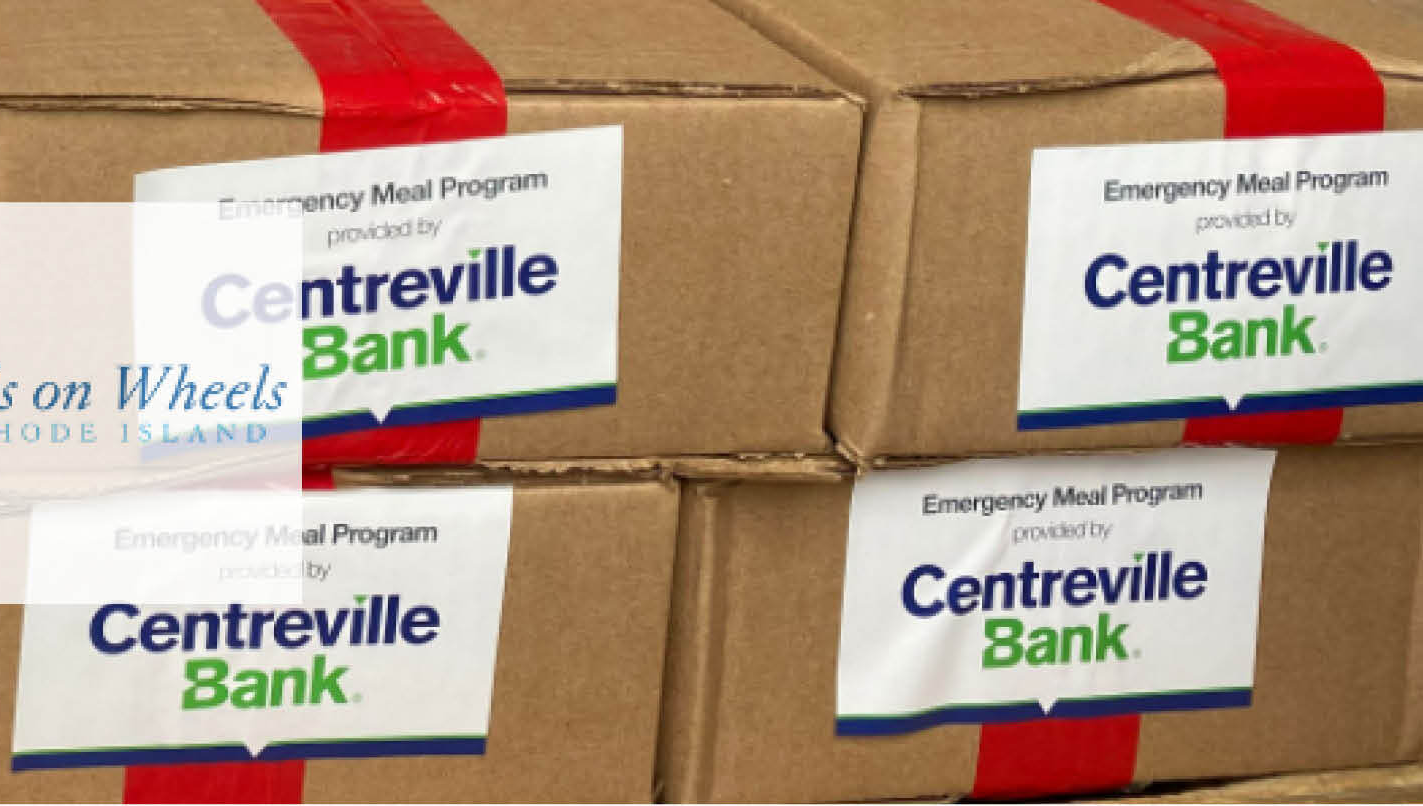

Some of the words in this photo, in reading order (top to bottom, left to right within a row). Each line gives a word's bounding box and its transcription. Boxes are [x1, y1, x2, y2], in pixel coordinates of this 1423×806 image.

[219, 188, 364, 220] Emergency
[371, 179, 432, 205] Meal
[442, 171, 548, 200] Program
[1104, 177, 1232, 204] Emergency
[1236, 171, 1290, 194] Meal
[1296, 169, 1389, 192] Program
[328, 221, 411, 248] provided
[416, 215, 442, 239] by
[1195, 210, 1271, 234] provided
[1274, 210, 1296, 229] by
[202, 244, 559, 329] Centreville
[1084, 239, 1394, 309] Centreville
[302, 313, 471, 381] Bank
[1166, 304, 1317, 364] Bank
[922, 490, 1047, 516] Emergency
[1052, 485, 1108, 508] Meal
[1112, 481, 1203, 506] Program
[113, 527, 259, 553] Emergency
[265, 524, 325, 546] Meal
[333, 523, 438, 548] Program
[1012, 521, 1088, 544] provided
[1090, 520, 1112, 540] by
[307, 560, 331, 582] by
[901, 550, 1208, 619] Centreville
[88, 594, 441, 655] Centreville
[982, 613, 1129, 669] Bank
[181, 654, 351, 711] Bank
